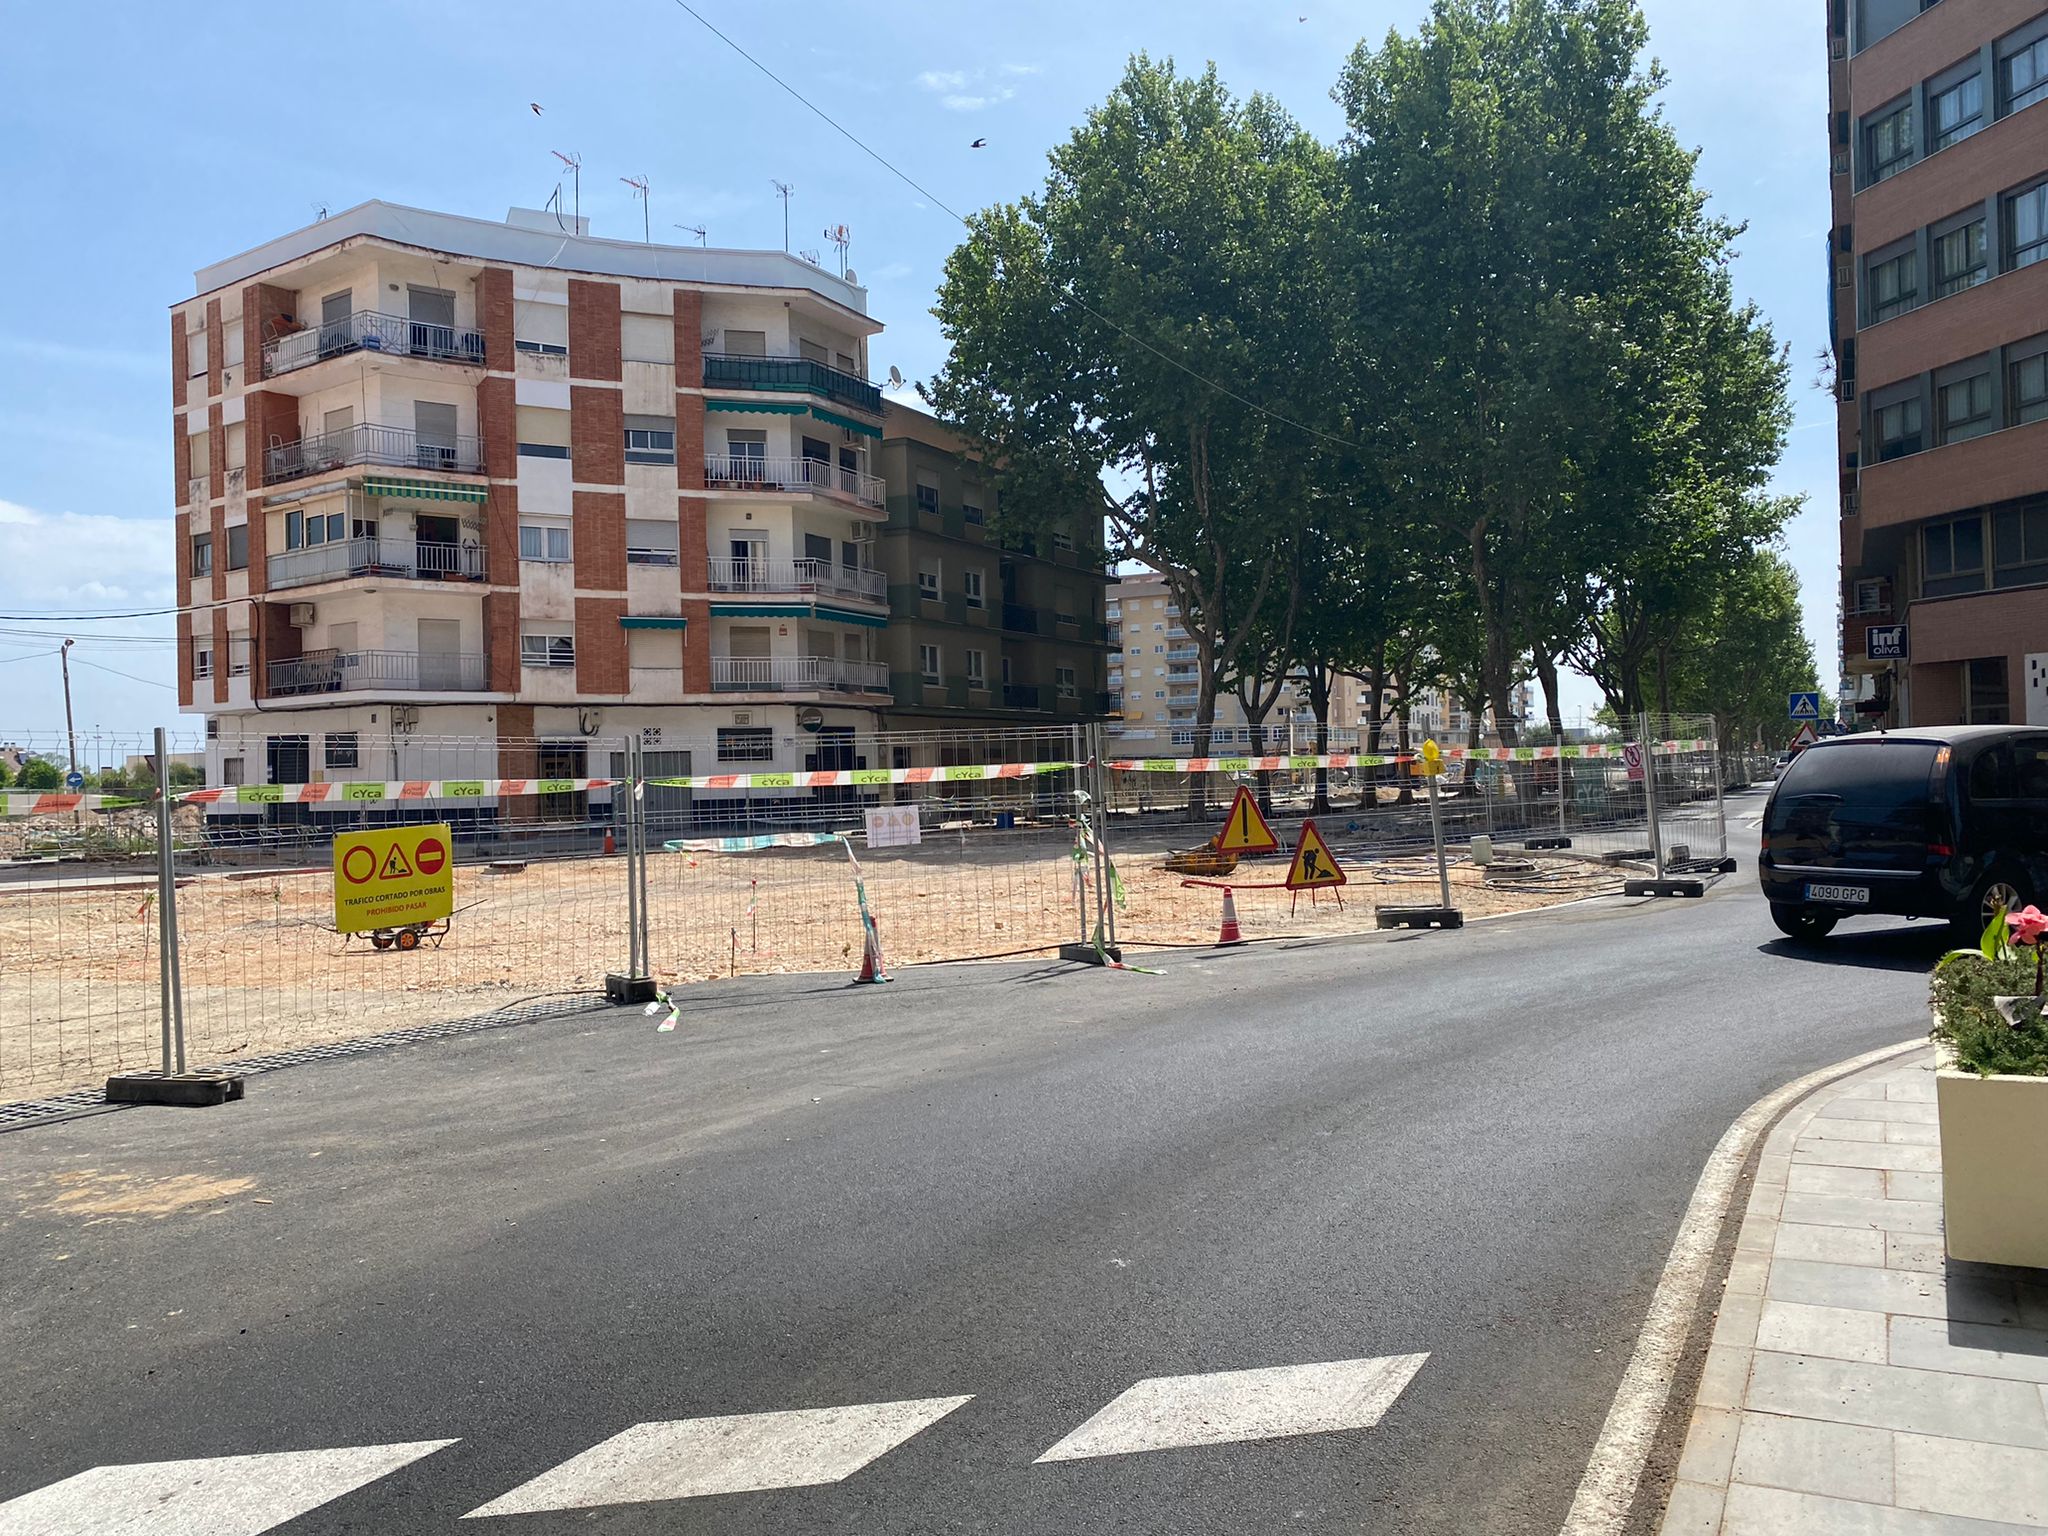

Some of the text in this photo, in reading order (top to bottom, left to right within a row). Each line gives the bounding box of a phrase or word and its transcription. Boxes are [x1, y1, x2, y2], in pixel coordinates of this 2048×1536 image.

[1872, 628, 1902, 645] inf
[1873, 645, 1901, 654] oliva
[344, 886, 446, 906] TRAFICO CORTADO POR OBRAS
[1811, 886, 1840, 899] 4090
[1842, 888, 1865, 901] GPG
[366, 902, 426, 916] PROHIBIDO PASAR
